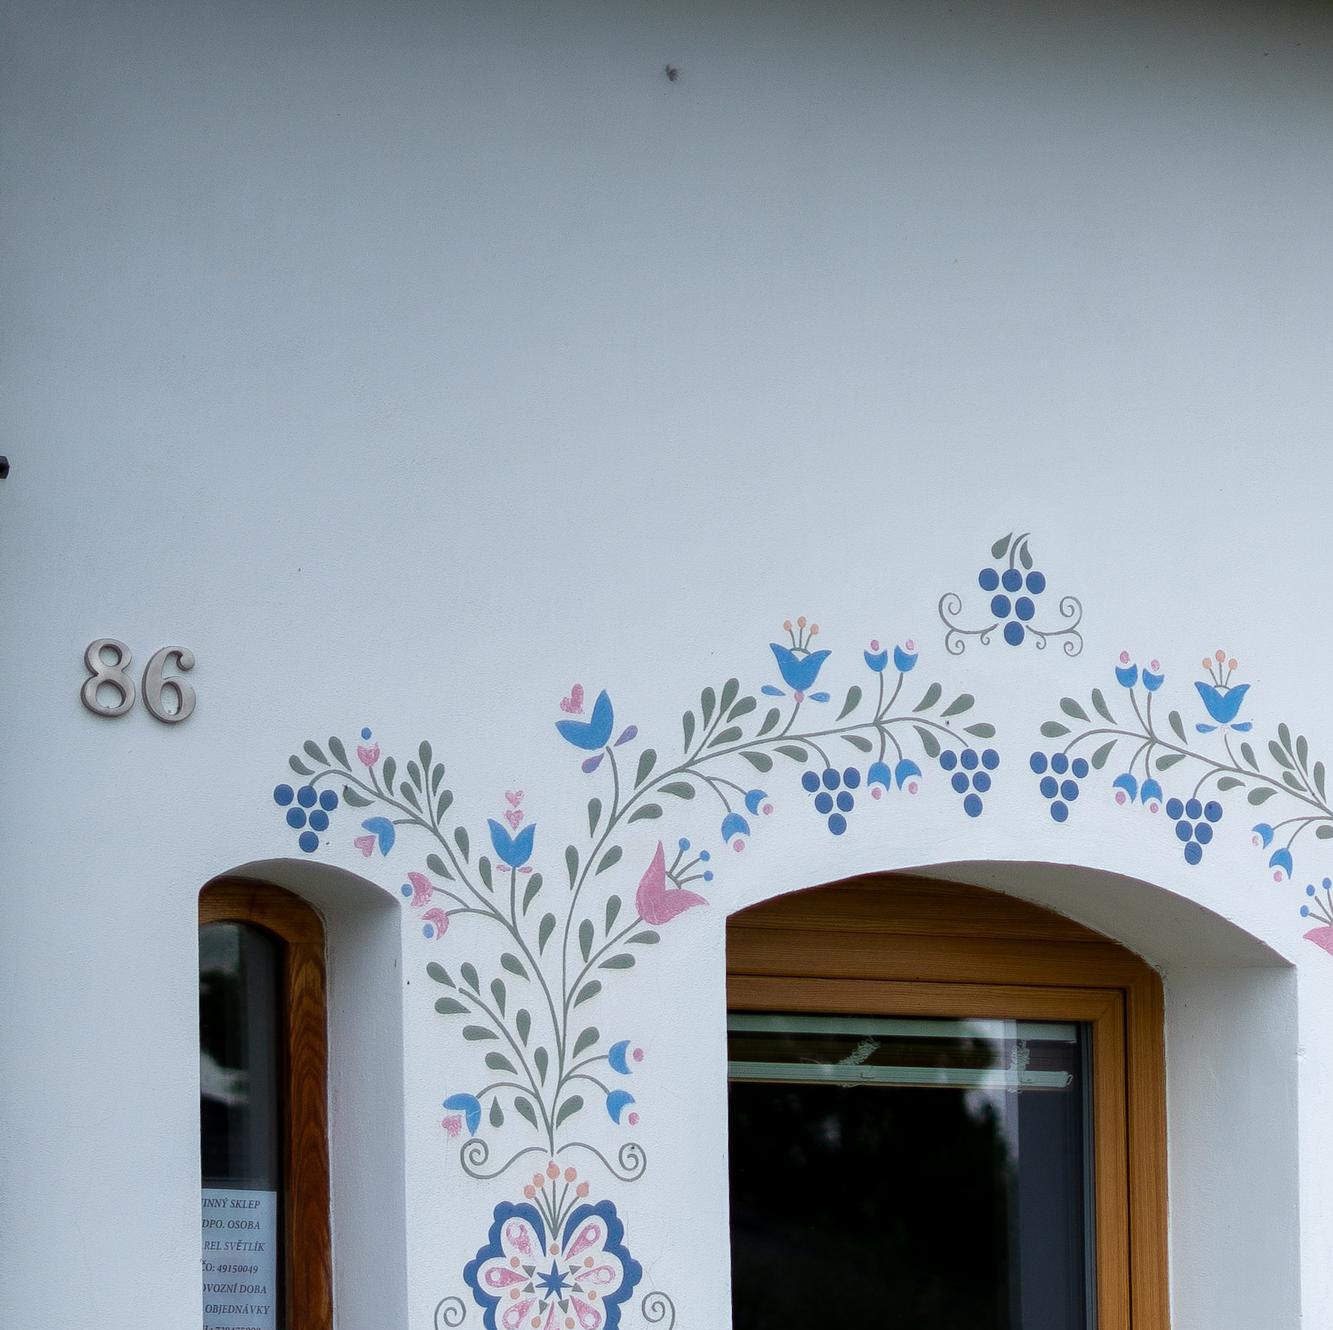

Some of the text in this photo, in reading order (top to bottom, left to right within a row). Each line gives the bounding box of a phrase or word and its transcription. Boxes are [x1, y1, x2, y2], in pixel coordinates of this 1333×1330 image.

[80, 638, 197, 723] 86
[230, 1199, 261, 1209] SKLEP
[202, 1219, 260, 1230] DPO. OSOBA
[204, 1239, 266, 1252] REL SVĚTLÍK
[217, 1264, 259, 1274] 49150049
[203, 1283, 267, 1294] VOZNÍ DOBA
[205, 1303, 271, 1315] OBJEDNÁVKY
